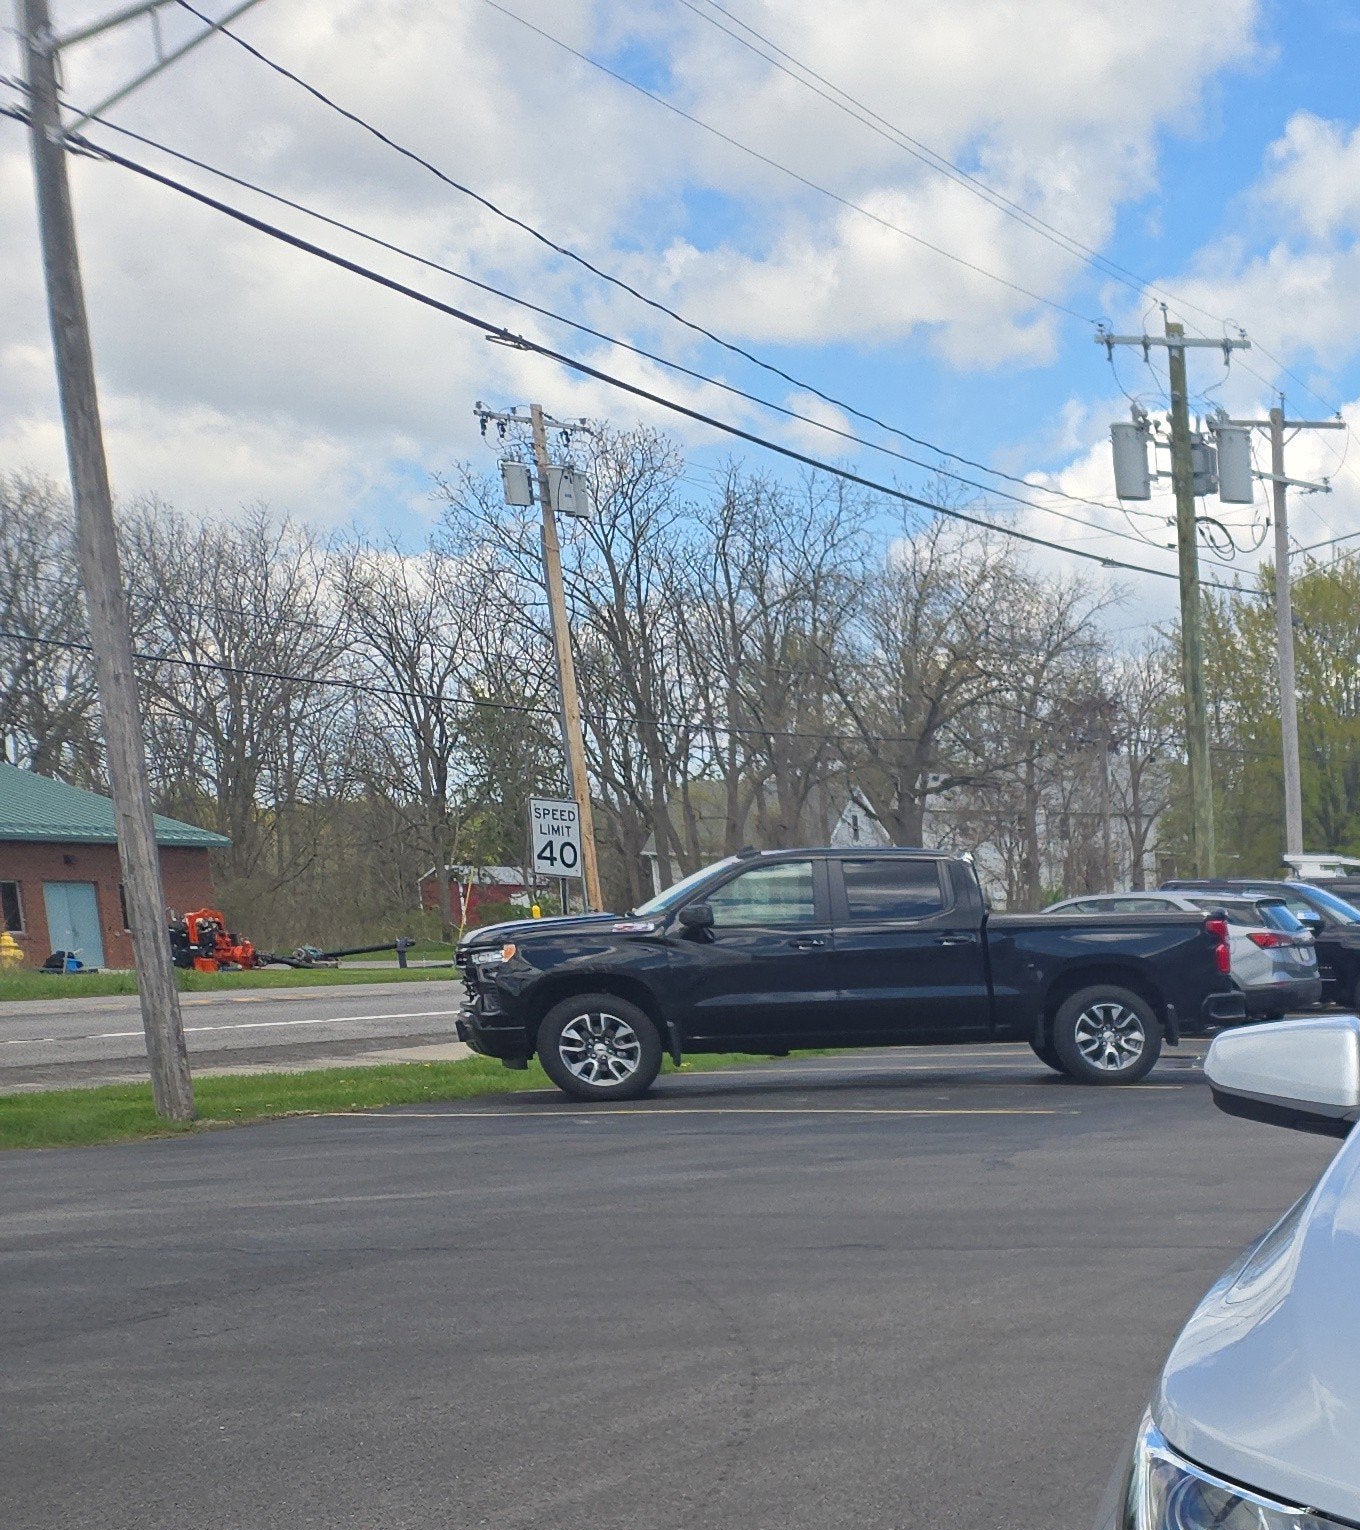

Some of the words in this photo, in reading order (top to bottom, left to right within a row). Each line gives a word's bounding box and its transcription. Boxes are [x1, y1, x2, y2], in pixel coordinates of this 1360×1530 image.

[534, 807, 576, 822] SPEED
[540, 824, 572, 837] LIMIT
[537, 840, 578, 869] 40
